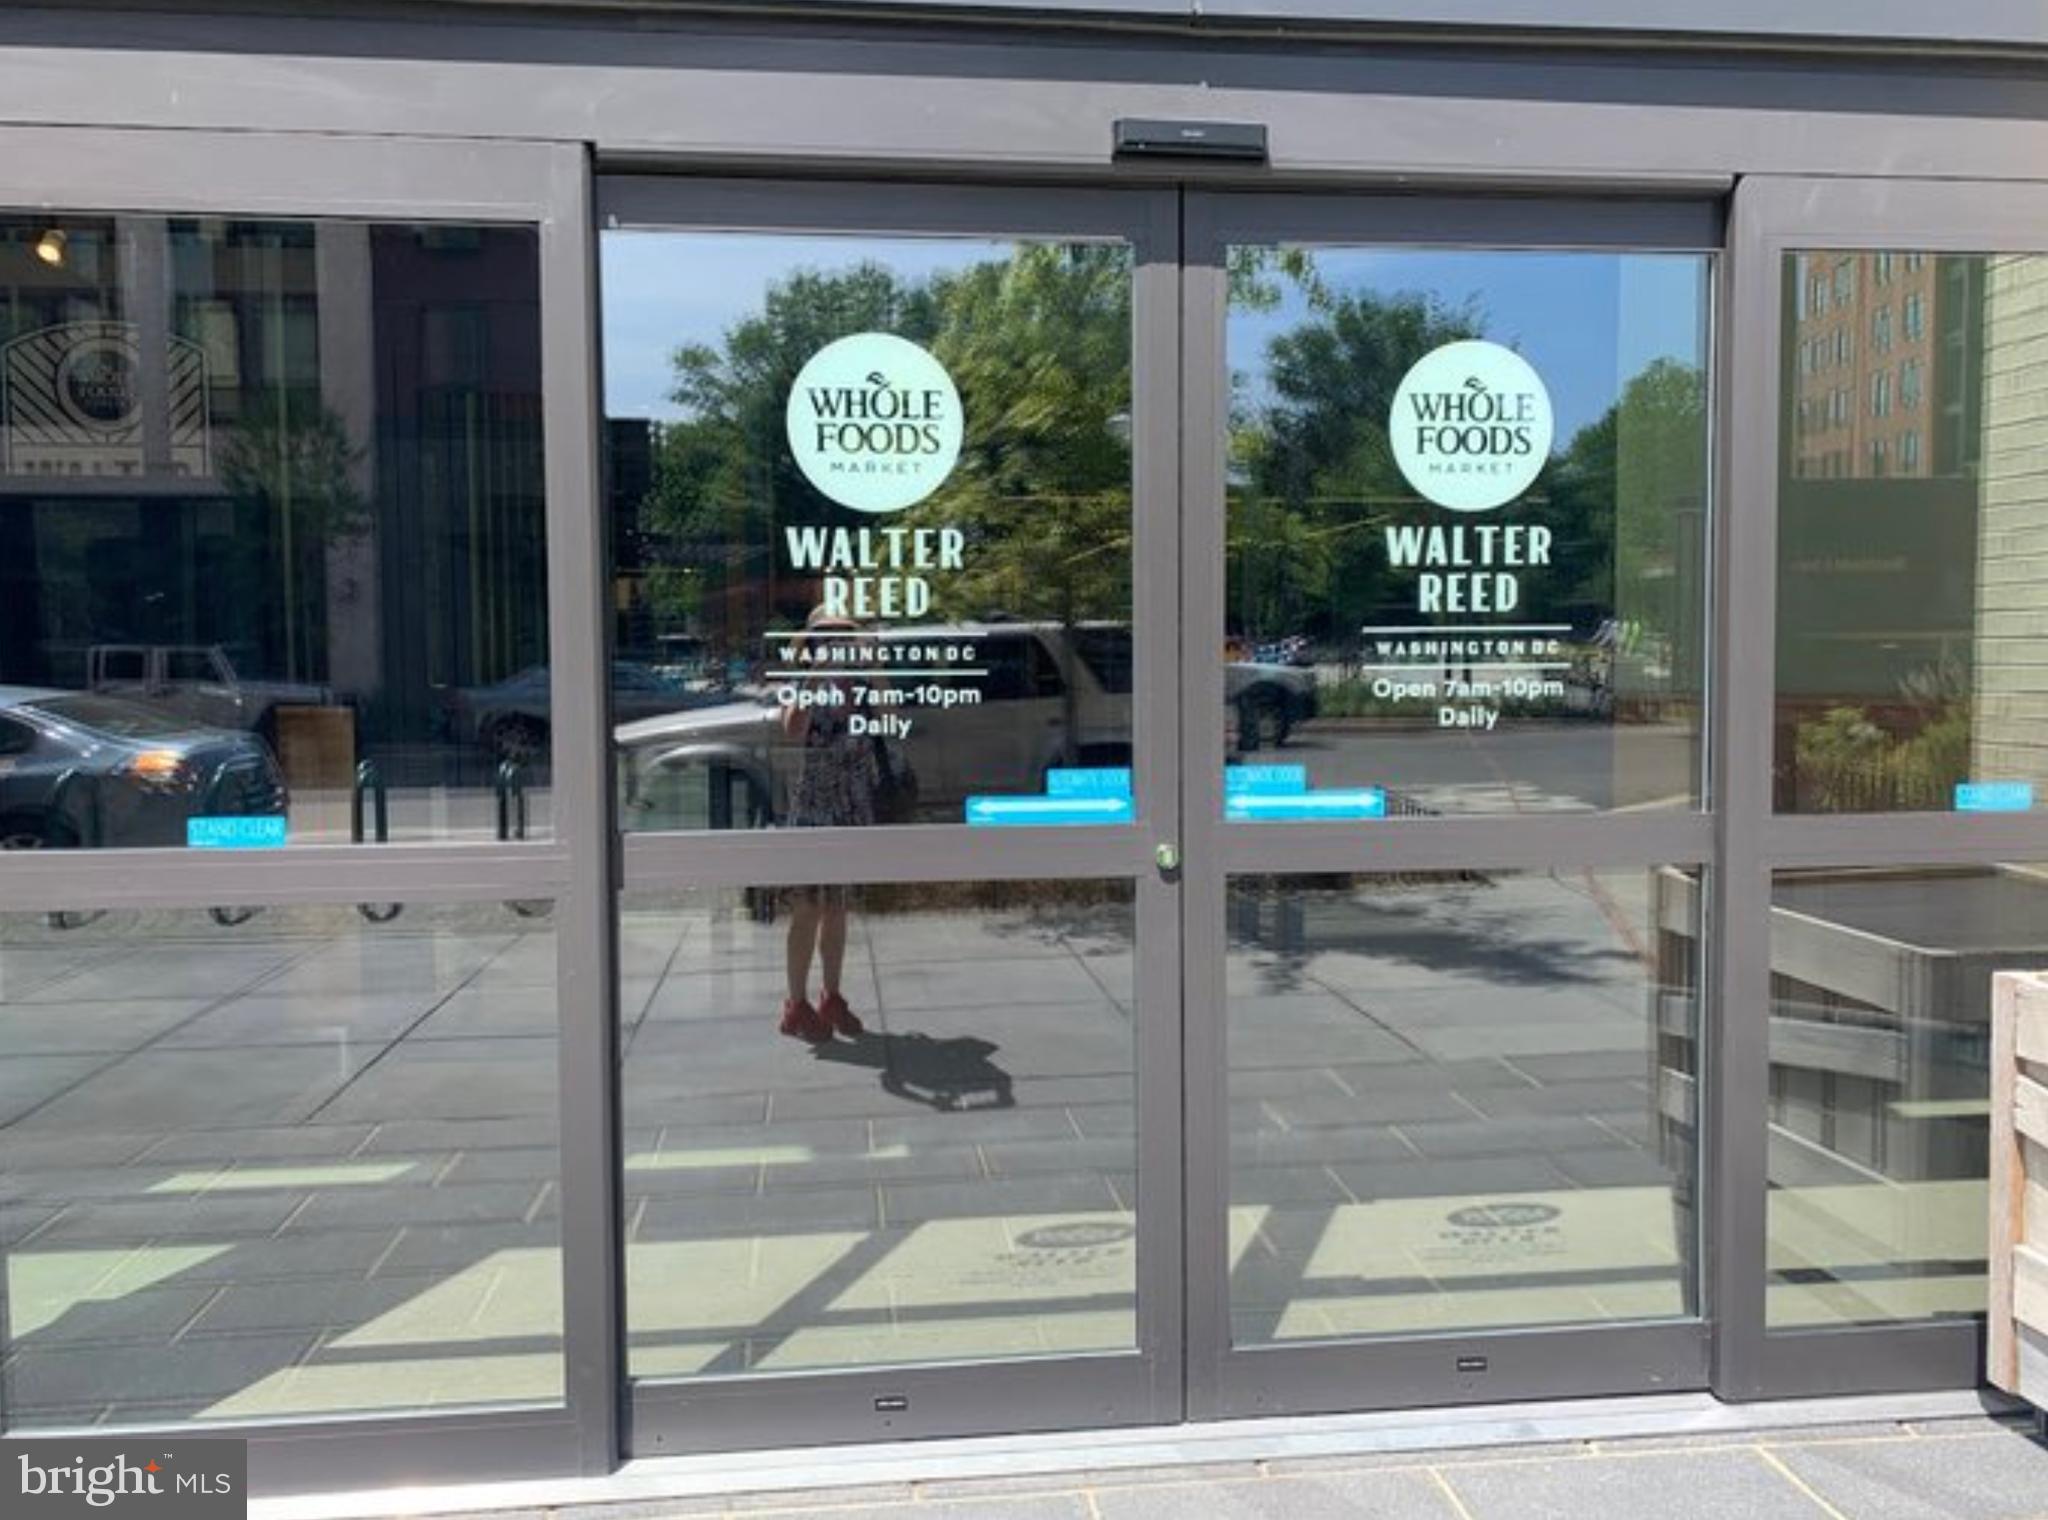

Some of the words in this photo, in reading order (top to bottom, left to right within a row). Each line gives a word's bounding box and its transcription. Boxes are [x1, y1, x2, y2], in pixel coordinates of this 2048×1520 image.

[807, 386, 944, 421] WHOLE
[1410, 389, 1535, 422] WHOLE
[816, 424, 941, 455] FOODS
[1416, 426, 1532, 455] FOODS
[829, 461, 923, 475] MARKET
[1428, 462, 1514, 475] MARKET
[786, 526, 965, 570] WALTER
[1386, 525, 1552, 567] WALTER
[823, 576, 930, 619] REED
[1418, 572, 1518, 613] REED
[779, 646, 940, 662] WASHINGTON
[945, 645, 976, 661] DC
[1375, 641, 1525, 656] WASHINGTON
[1530, 639, 1560, 655] DC
[777, 686, 845, 709] Open
[852, 685, 982, 709] 7am-10pm
[1373, 678, 1437, 702] Open
[1443, 677, 1564, 702] 7am-10pm
[848, 714, 912, 739] Daily
[1438, 706, 1499, 730] Daily
